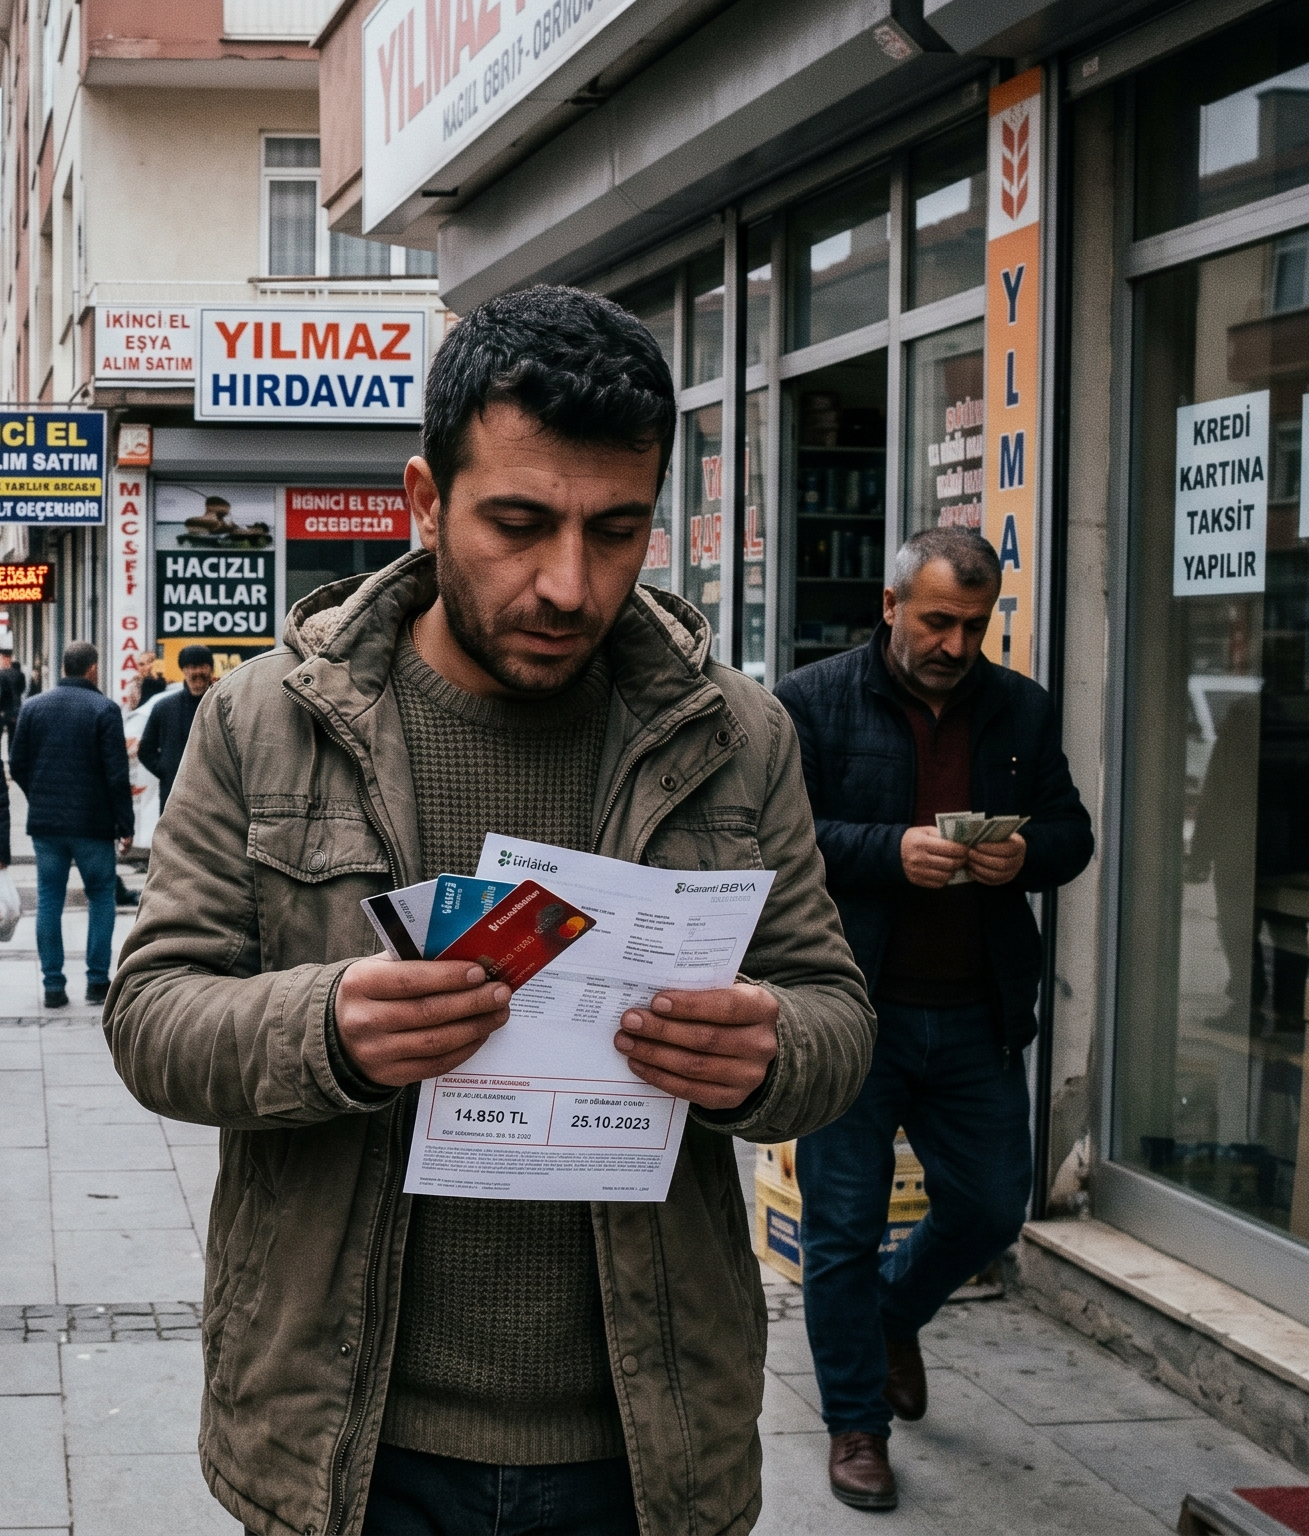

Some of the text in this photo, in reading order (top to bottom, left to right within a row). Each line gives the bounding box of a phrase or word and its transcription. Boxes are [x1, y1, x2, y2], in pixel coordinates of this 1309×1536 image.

[105, 310, 191, 329] İKİNCİ EL
[125, 335, 171, 353] EŞYA
[215, 321, 411, 361] YILMAZ
[102, 357, 192, 371] ALIM SATIM
[212, 373, 413, 408] HIRDAVAT
[46, 422, 88, 447] EL
[1193, 404, 1250, 446] KREDİ
[32, 453, 98, 471] SATIM
[1180, 456, 1264, 492] KARTINA
[349, 495, 364, 511] EL
[367, 495, 405, 515] EŞYA
[1187, 498, 1255, 535] TAKSİT
[166, 557, 265, 579] HACIZLI
[1183, 551, 1256, 581] YAPILIR
[163, 584, 267, 605] MALLAR
[163, 611, 267, 633] DEPOSU
[687, 883, 756, 893] Garanti BBVA
[455, 1108, 528, 1125] 14.850 TL
[571, 1115, 650, 1130] 25.10.2023
